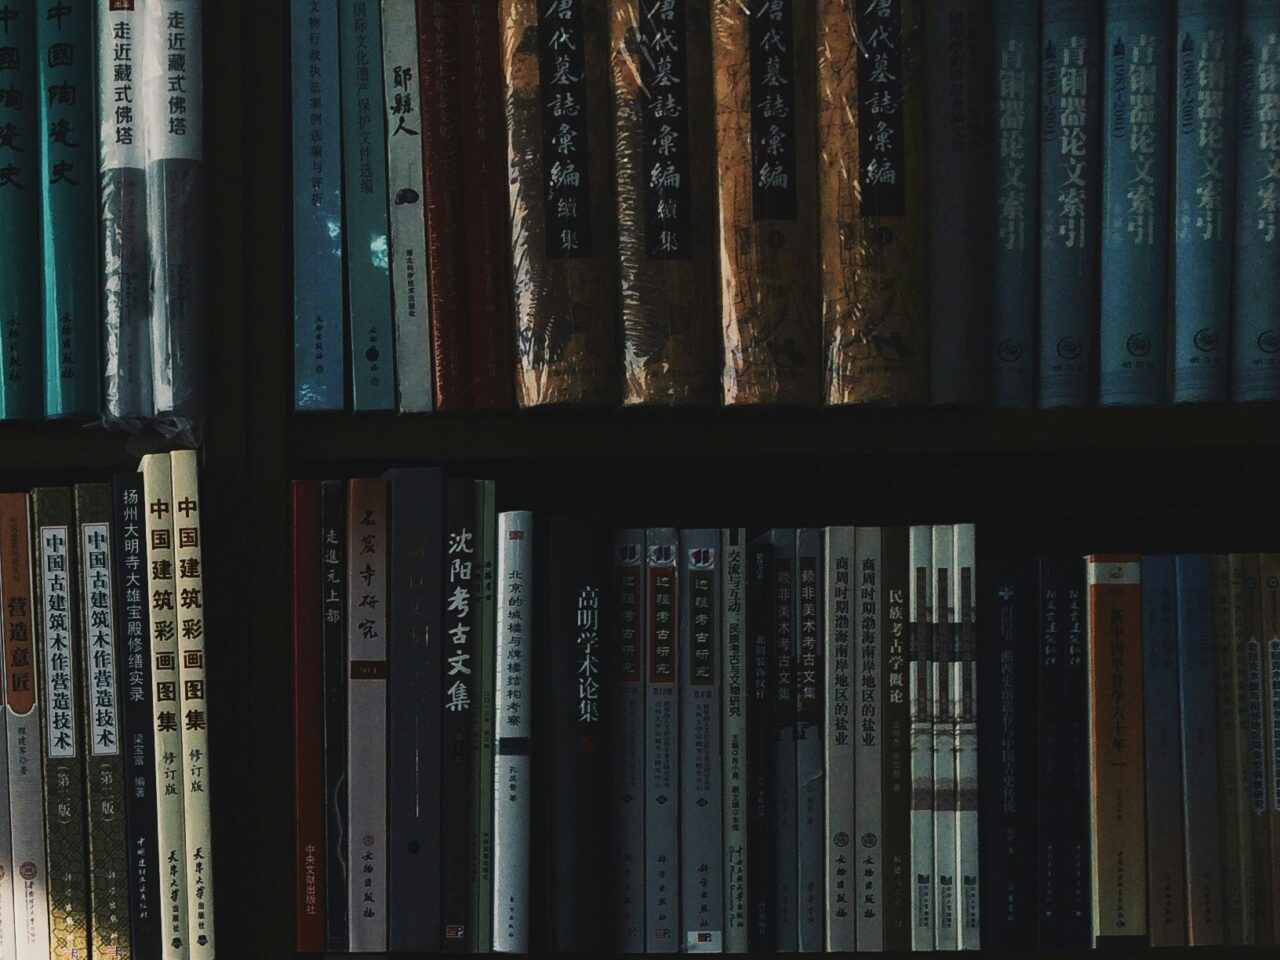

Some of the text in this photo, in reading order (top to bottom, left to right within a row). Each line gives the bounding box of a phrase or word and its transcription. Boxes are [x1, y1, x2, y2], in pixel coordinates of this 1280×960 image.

[113, 21, 134, 145] 走近藏式佛塔
[167, 11, 187, 136] 走近藏式佛塔
[7, 596, 30, 692] 营造意匠
[46, 534, 71, 750] 中国古建筑木作营造技术
[88, 530, 114, 747] 中国古建筑木作营造技术
[123, 489, 144, 702] 扬州大明寺大雄宝殿修缮实录
[150, 499, 178, 732] 中国建筑彩画图集
[178, 497, 206, 730] 中国建筑彩画图集
[325, 530, 340, 623] 走進元上都
[445, 527, 473, 712] 沈阳考古文集
[507, 570, 522, 726] 北京的城楼与牌楼结构考察
[889, 590, 904, 703] 民族考古学概论
[577, 586, 600, 723] 高明学术论集
[835, 556, 849, 746] 商周时期渤海南岸地区的盐业
[163, 752, 178, 796] 修订版
[189, 749, 204, 793] 修订版
